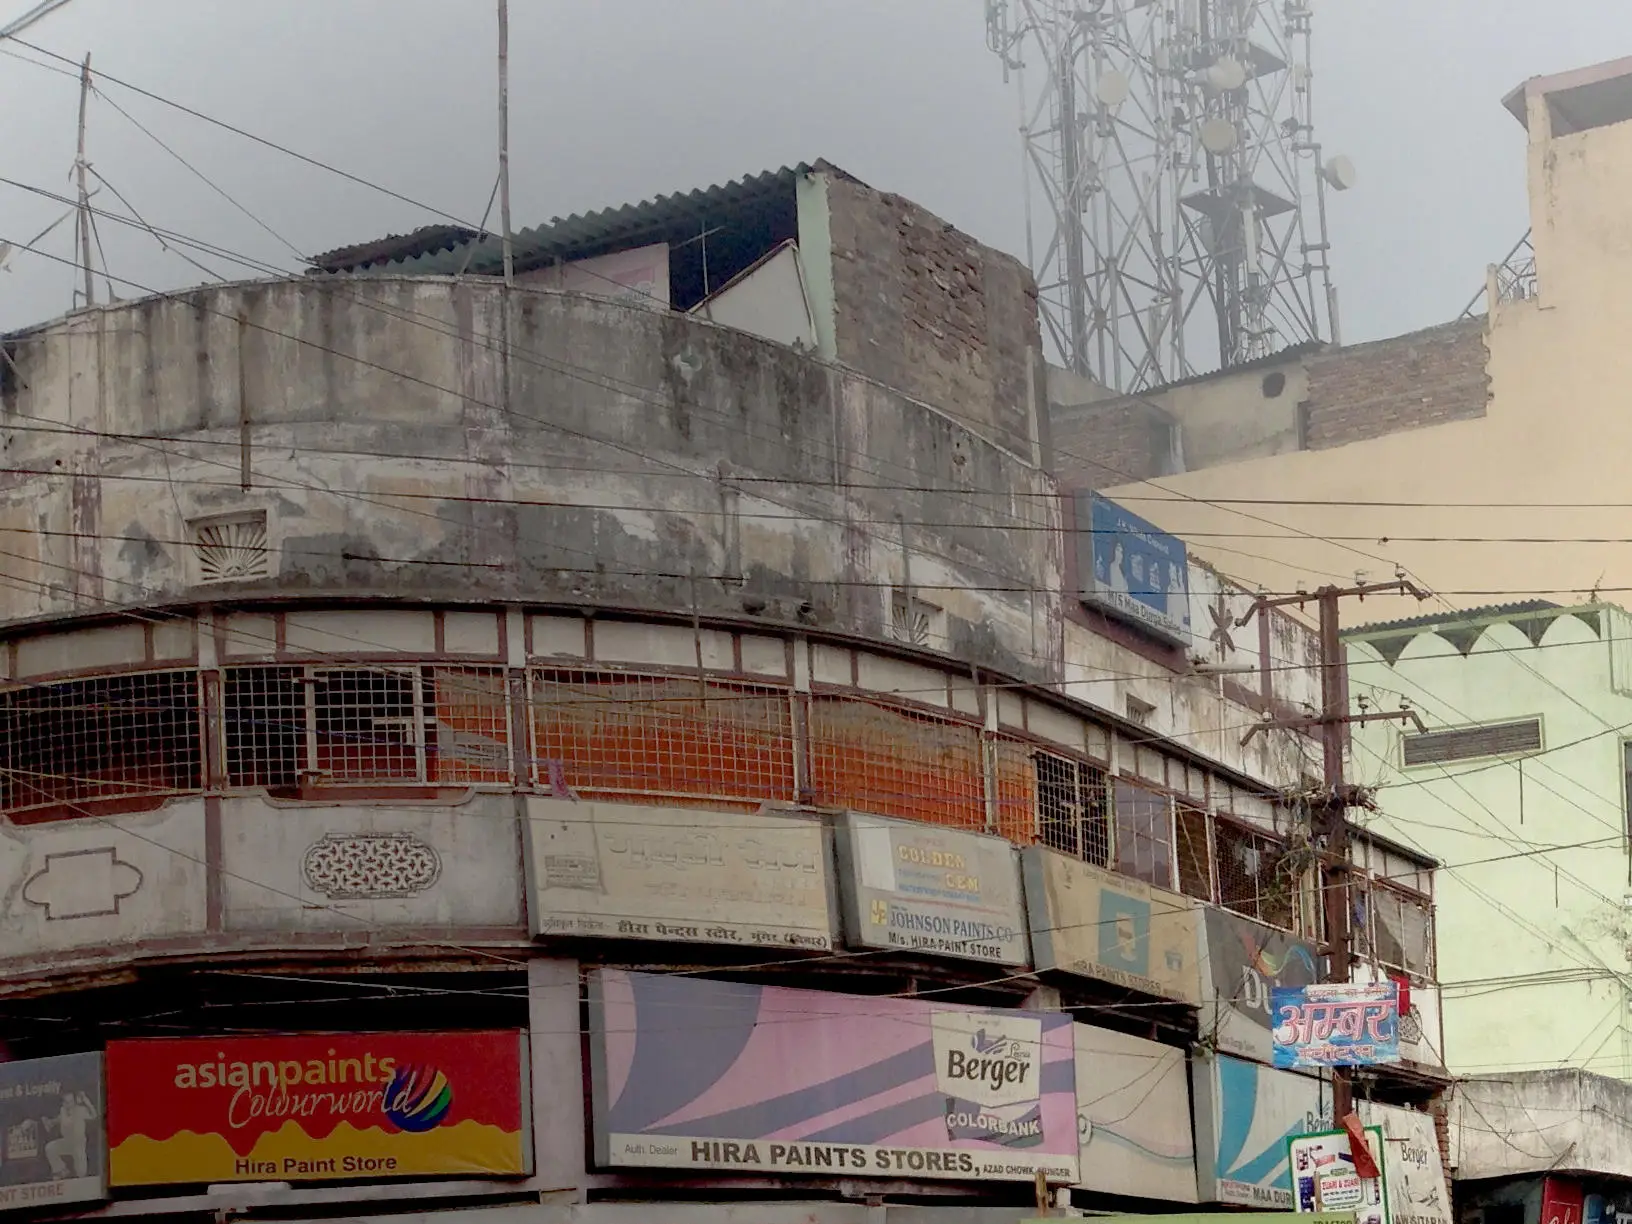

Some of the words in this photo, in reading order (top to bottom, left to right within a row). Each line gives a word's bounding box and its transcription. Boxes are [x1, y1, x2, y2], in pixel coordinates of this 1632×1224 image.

[890, 911, 951, 934] JOHNSON
[953, 919, 993, 939] PAINTS
[911, 936, 936, 949] HIRA
[938, 939, 967, 954] PAINT
[970, 944, 1001, 958] STORE
[1275, 1000, 1397, 1045] अम्बर
[174, 1048, 397, 1094] asianpaints
[947, 1050, 1030, 1091] Berger
[228, 1070, 413, 1129] Colourworld
[946, 1112, 1040, 1137] COLORBANK
[235, 1158, 277, 1174] Hira
[283, 1157, 336, 1174] Paint
[343, 1156, 397, 1172] Store
[650, 1144, 678, 1156] Dealer
[691, 1141, 761, 1164] HIRA
[770, 1144, 867, 1167] PAINTS
[875, 1149, 981, 1176] STORES,
[983, 1164, 1004, 1174] AZAD
[1400, 1142, 1428, 1171] Berger
[21, 1182, 65, 1200] STORE
[1253, 1187, 1272, 1202] MAA
